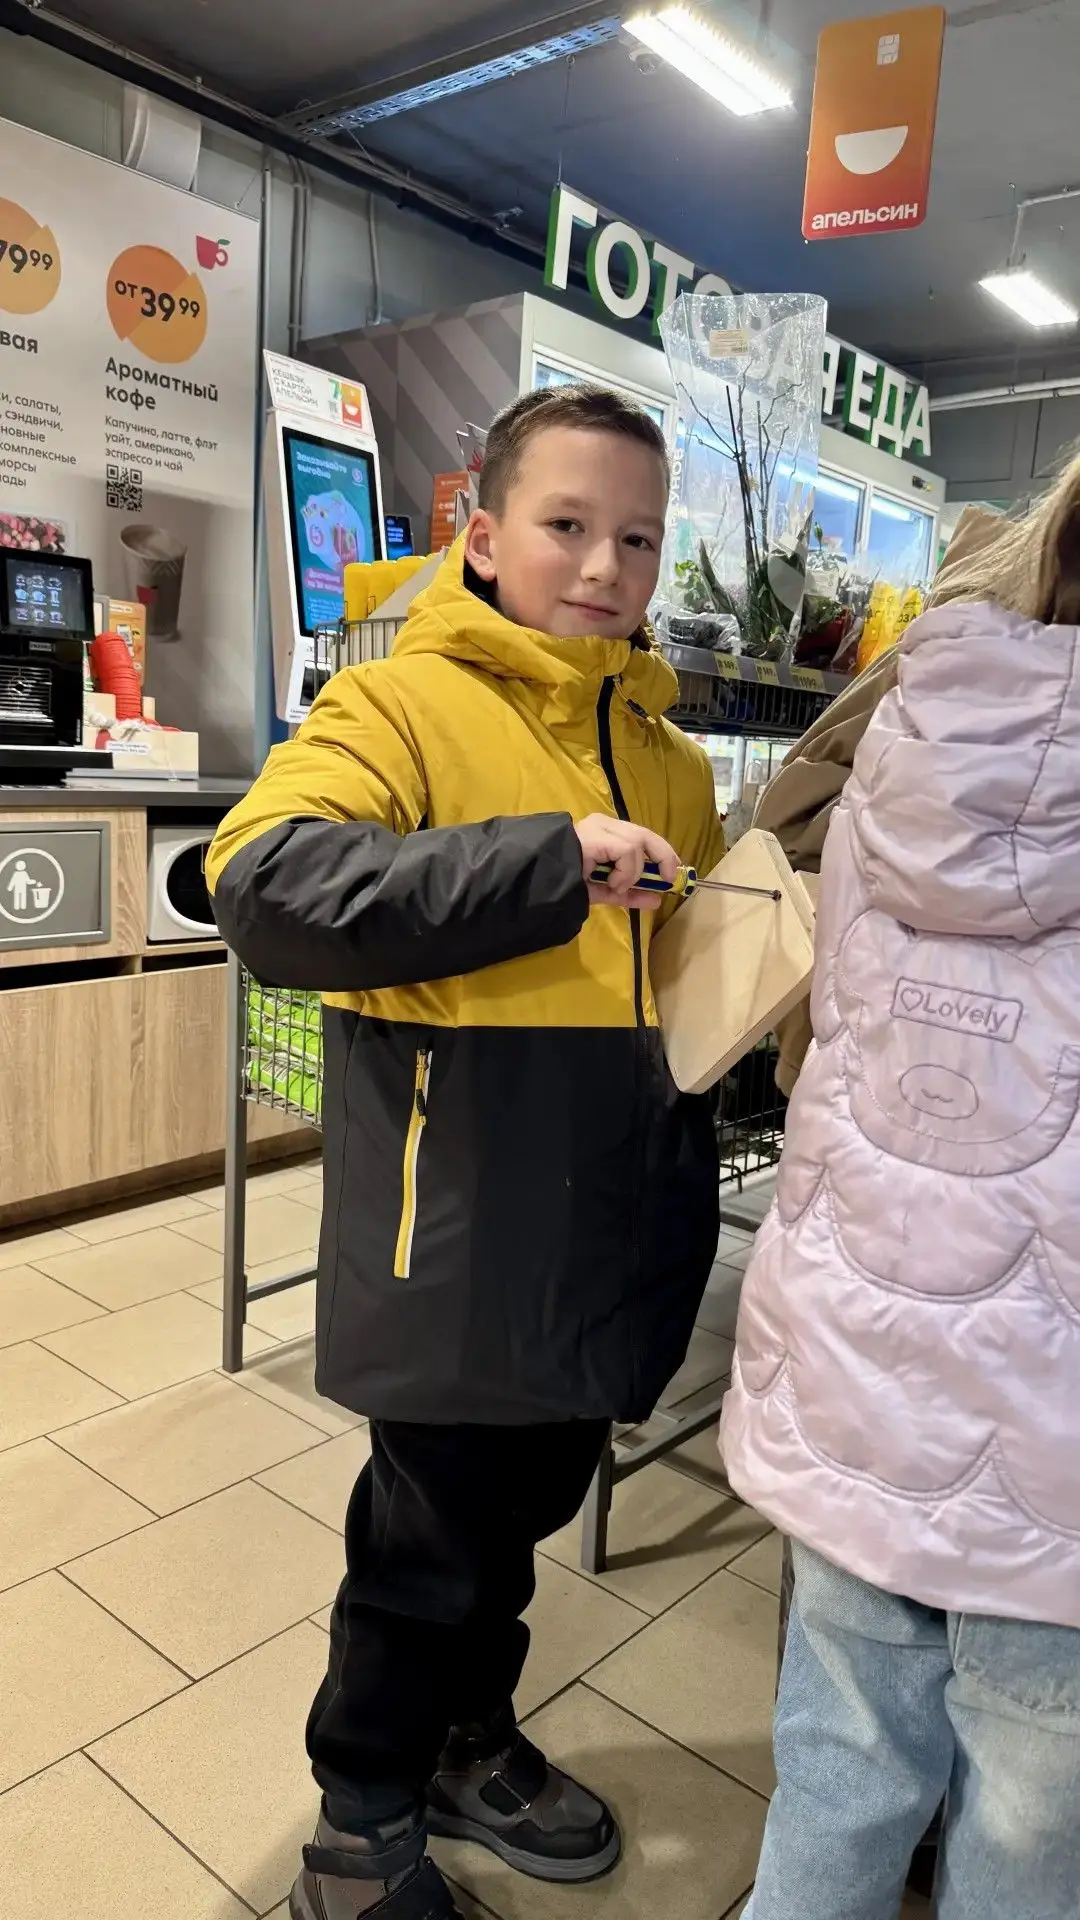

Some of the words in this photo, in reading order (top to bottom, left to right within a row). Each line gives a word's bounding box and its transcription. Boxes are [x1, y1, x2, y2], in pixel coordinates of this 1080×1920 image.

[811, 203, 918, 230] апельсин
[105, 356, 218, 402] Ароматный
[15, 394, 62, 416] салаты,
[105, 385, 157, 411] кофе
[848, 353, 931, 458] ЕДА
[4, 409, 64, 432] сэндвичи,
[105, 415, 159, 438] Капучино,
[161, 430, 193, 446] латте,
[195, 436, 218, 450] флэт
[104, 447, 153, 466] эспрессо
[155, 458, 162, 467] и
[164, 460, 183, 472] чай
[105, 432, 132, 447] уайт,
[134, 438, 196, 461] американо,
[923, 992, 1008, 1034] Lovely
